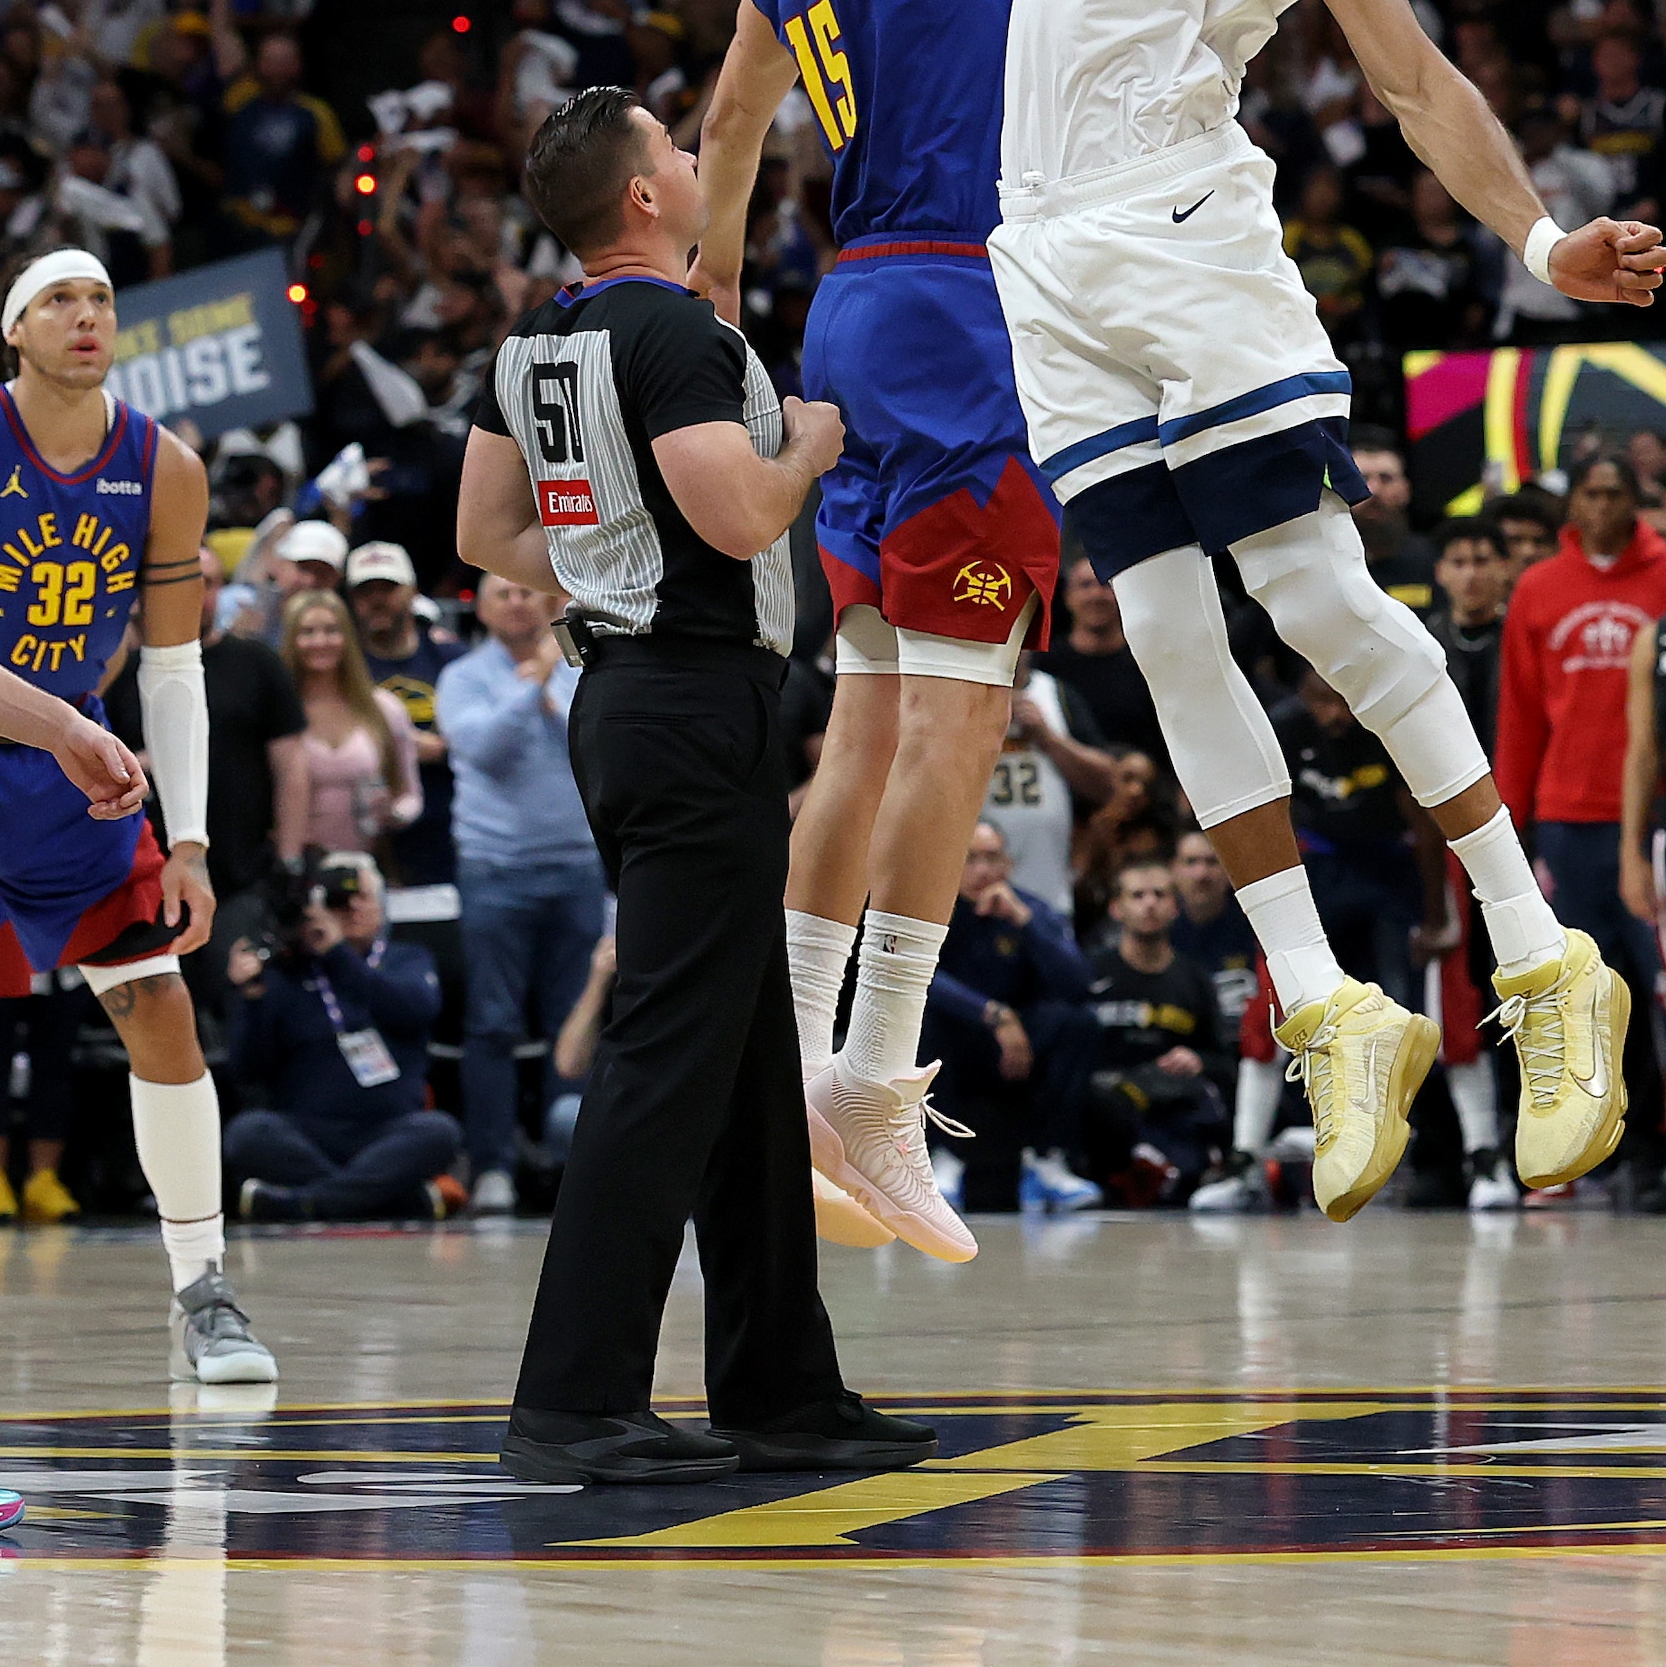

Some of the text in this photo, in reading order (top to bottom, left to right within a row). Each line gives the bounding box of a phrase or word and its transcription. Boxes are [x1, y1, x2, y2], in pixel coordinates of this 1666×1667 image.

[533, 361, 585, 464] 51
[96, 478, 143, 496] ibotta
[72, 512, 137, 594] HIGH
[27, 560, 98, 627] 32
[10, 634, 87, 672] CITY
[992, 763, 1042, 806] 32
